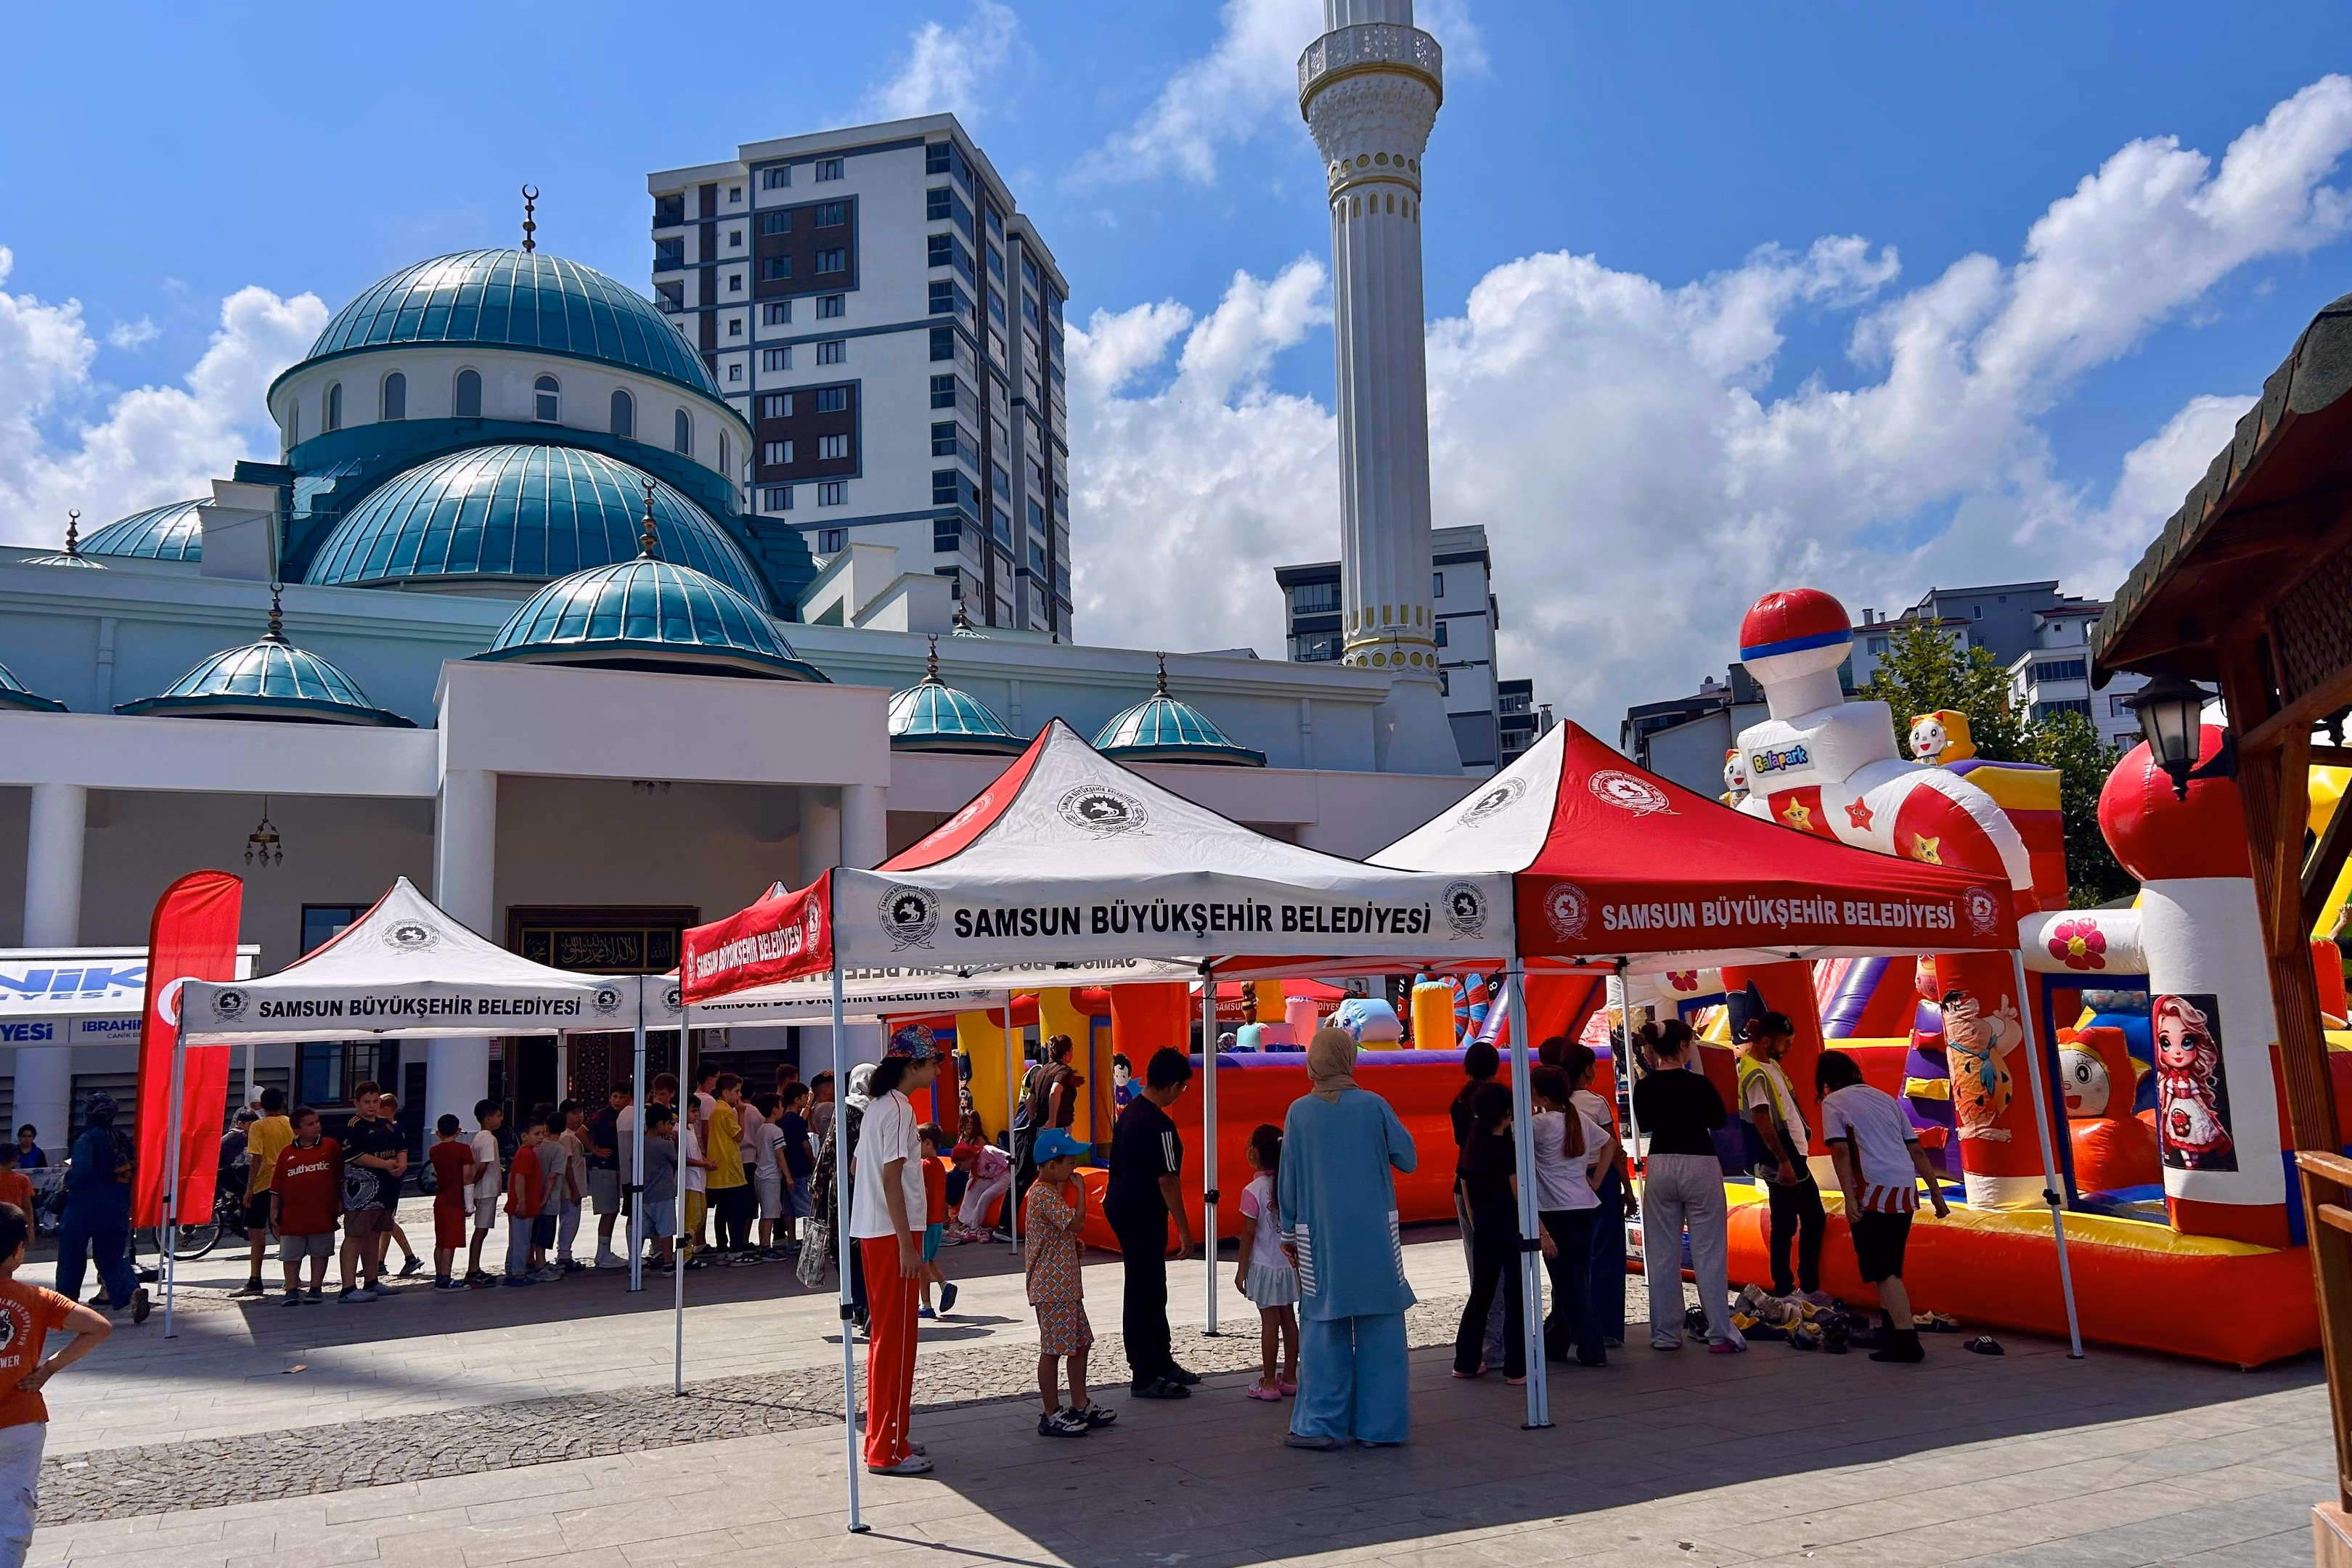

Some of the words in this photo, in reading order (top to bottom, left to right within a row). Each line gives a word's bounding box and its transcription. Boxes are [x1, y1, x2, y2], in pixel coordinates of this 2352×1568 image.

[1752, 745, 1808, 773] Balapark
[955, 906, 1081, 939] SAMSUN
[1091, 898, 1273, 939] BÜYÜKŞEHİR
[1281, 901, 1431, 934] BELEDİYESİ
[1602, 902, 1696, 931] SAMSUN
[1701, 894, 1839, 930] BÜYÜKŞEHİR
[1842, 898, 1956, 929] BELEDİYESİ
[696, 948, 718, 980] SAMSUN
[718, 931, 758, 973] BÜYÜKŞEHİR
[758, 918, 803, 961] BELEDİYESİ
[259, 1000, 343, 1018] SAMSUN
[350, 995, 473, 1018] BÜYÜKŞEHİR
[478, 997, 581, 1016] BELEDİYESİ
[1215, 1003, 1243, 1011] SAMSU
[287, 1161, 330, 1177] authentic
